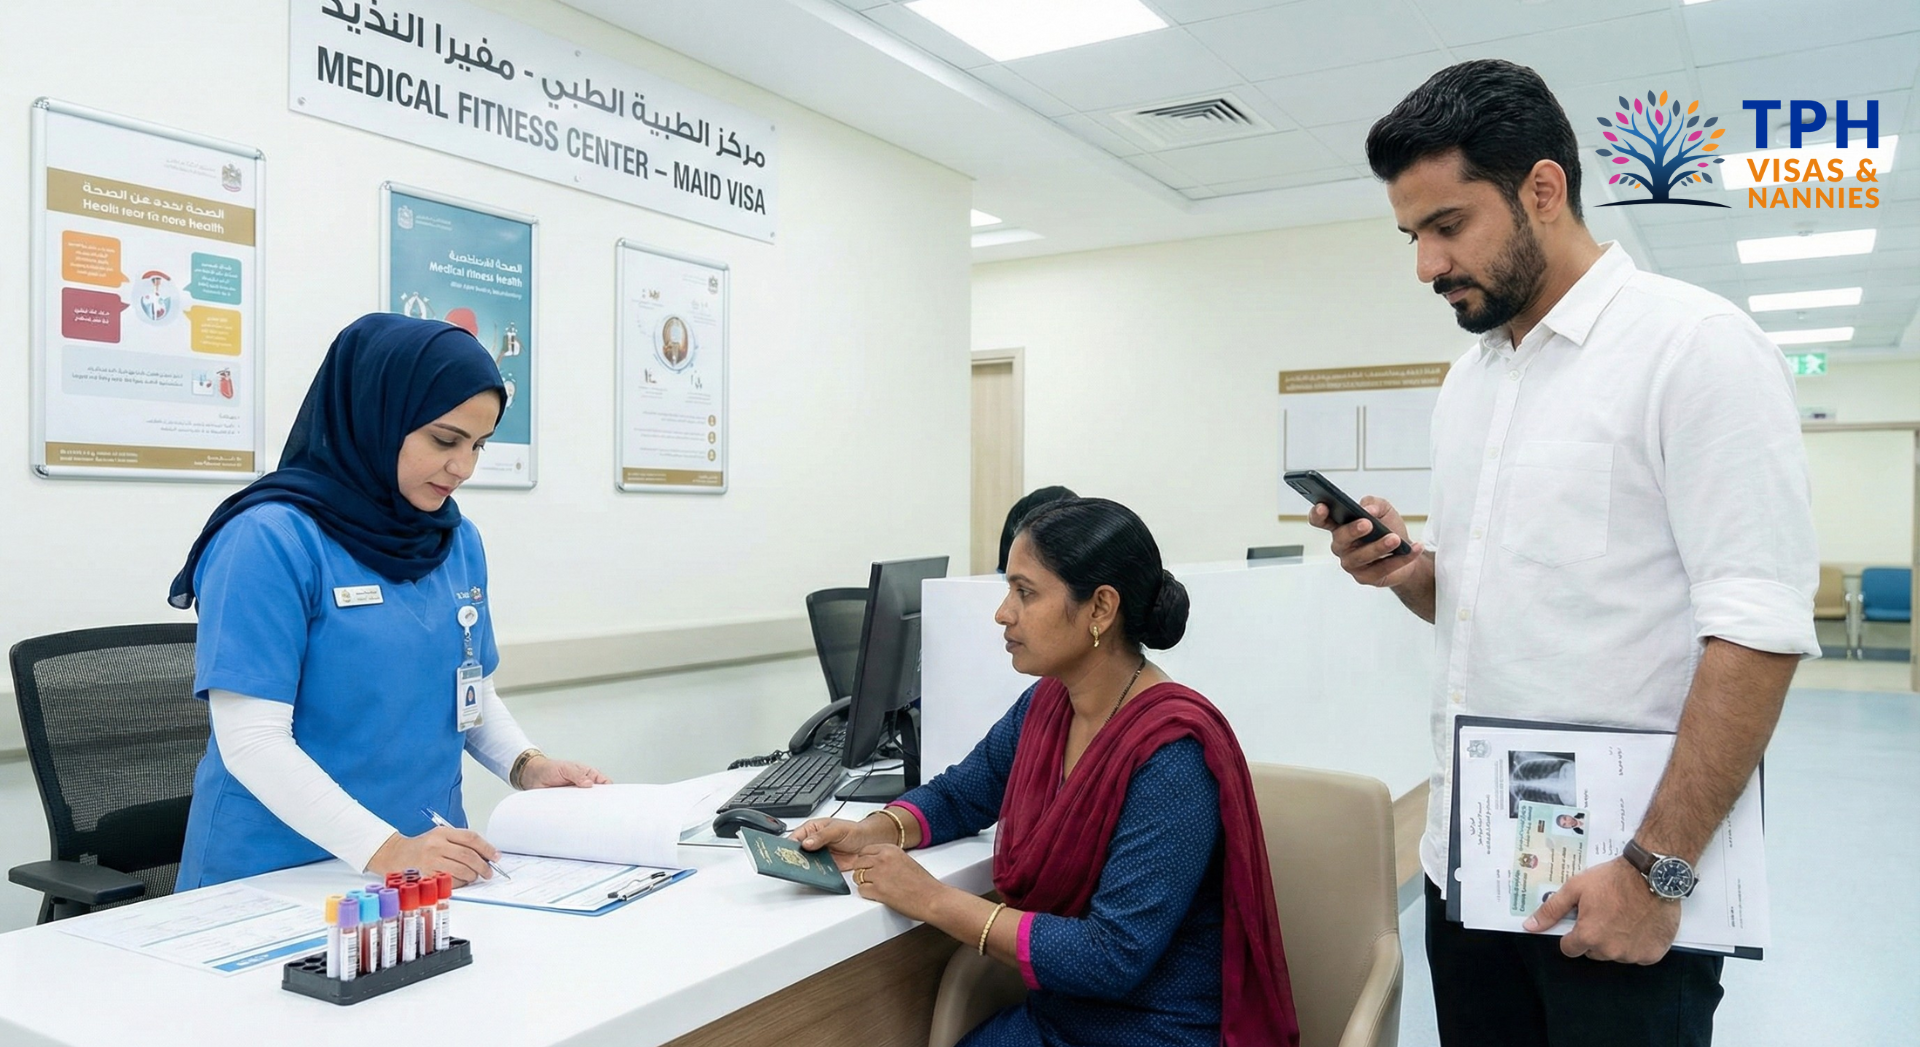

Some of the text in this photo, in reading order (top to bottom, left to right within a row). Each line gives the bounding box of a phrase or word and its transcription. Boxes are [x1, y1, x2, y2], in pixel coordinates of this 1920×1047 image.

[523, 69, 534, 78] -
[542, 78, 624, 118] الطبي
[318, 45, 448, 120] MEDICAL
[459, 91, 559, 151] FITNESS
[567, 127, 648, 180] CENTER
[673, 161, 721, 200] MAID
[727, 178, 766, 215] VISA
[632, 92, 709, 147] الطبية
[716, 127, 765, 168] مركز
[83, 181, 127, 200] الصحة
[429, 261, 464, 277] Medical
